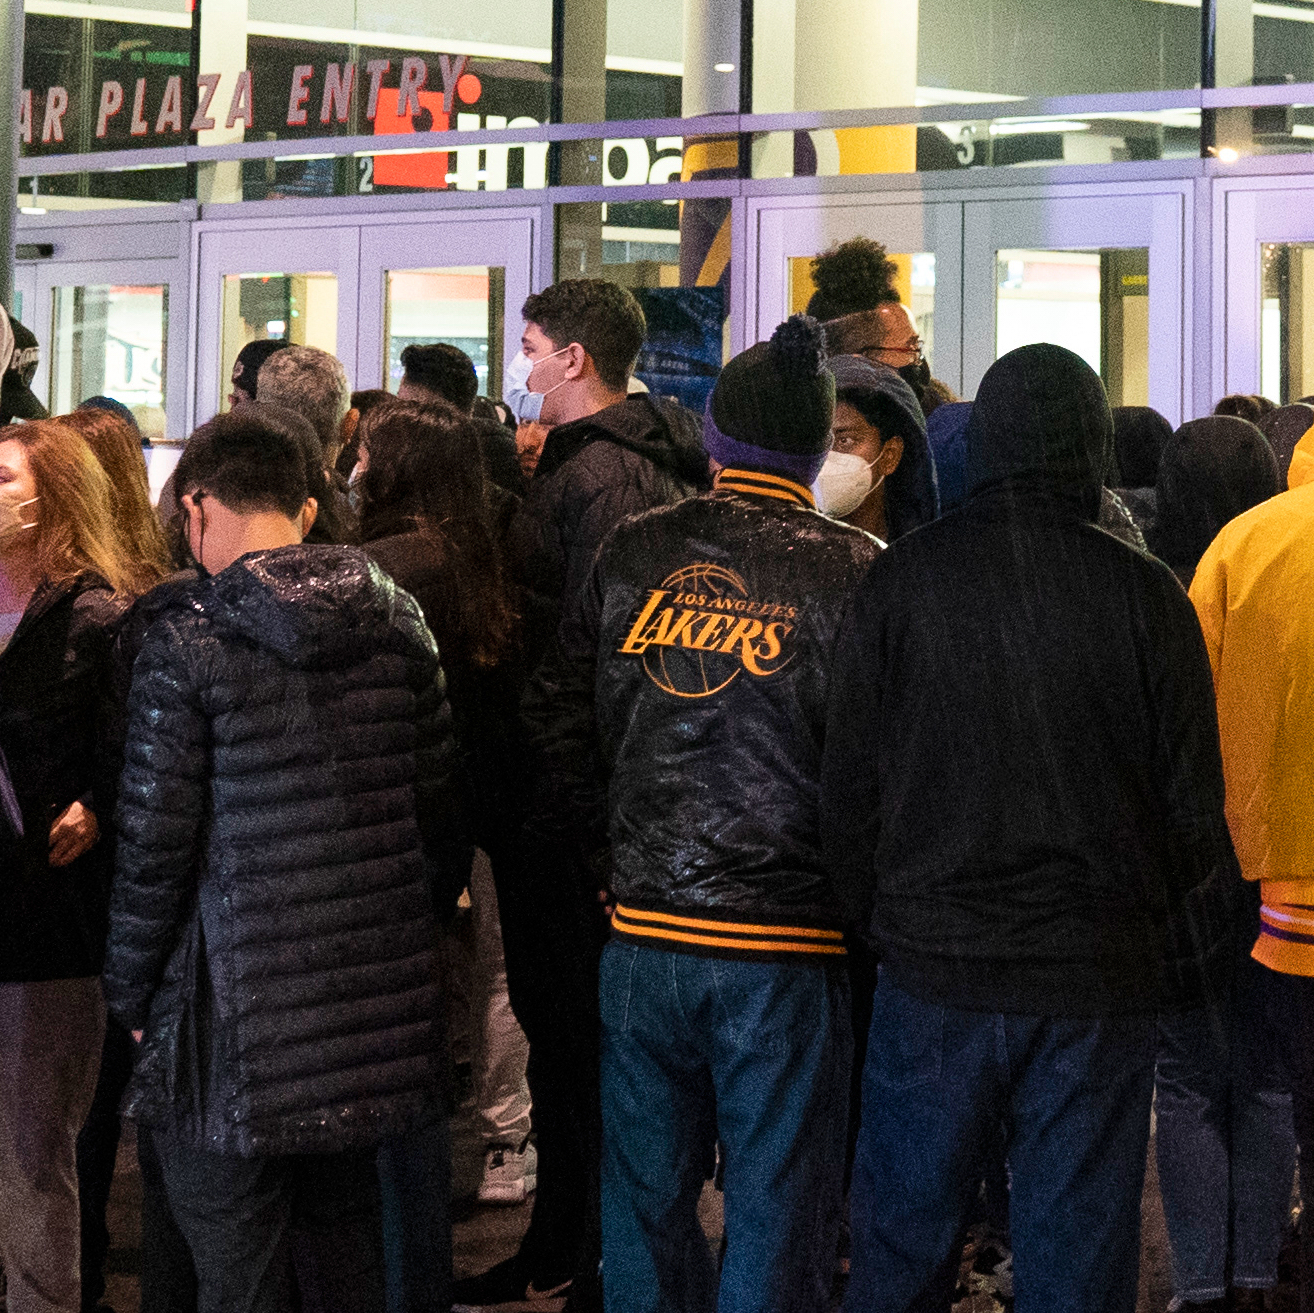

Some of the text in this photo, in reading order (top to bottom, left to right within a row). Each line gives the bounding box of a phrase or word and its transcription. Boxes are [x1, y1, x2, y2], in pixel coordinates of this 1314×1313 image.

[95, 69, 254, 139] PLAZA
[286, 53, 473, 127] ENTRY
[957, 124, 977, 166] 3
[358, 156, 374, 193] 2
[672, 591, 799, 620] LOS ANGELES
[617, 588, 796, 677] LAKERS
